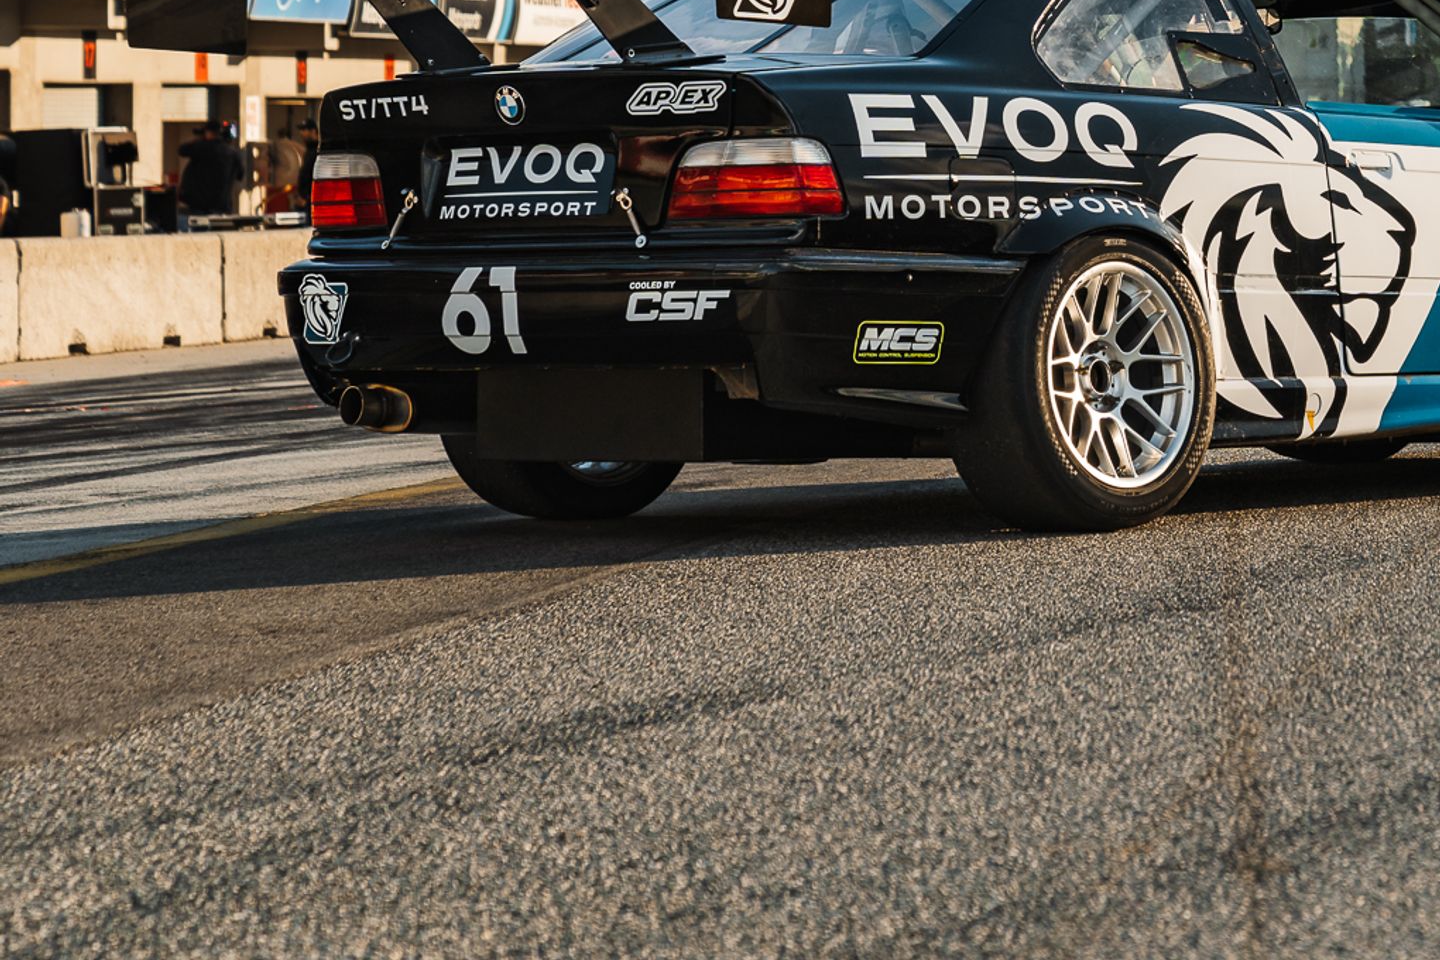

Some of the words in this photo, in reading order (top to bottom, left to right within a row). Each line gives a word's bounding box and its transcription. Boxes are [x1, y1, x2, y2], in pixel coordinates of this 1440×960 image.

[338, 95, 429, 121] ST/TT4
[631, 83, 725, 110] APEX
[847, 93, 1139, 169] EVOQ
[446, 142, 605, 187] EVOQ
[439, 201, 598, 220] MOTORSPORT
[865, 195, 1150, 221] MOTORSPORT
[629, 281, 662, 290] COOLED
[663, 280, 676, 289] BY
[441, 266, 528, 355] 61
[625, 290, 731, 322] CSF
[859, 327, 940, 351] MCS
